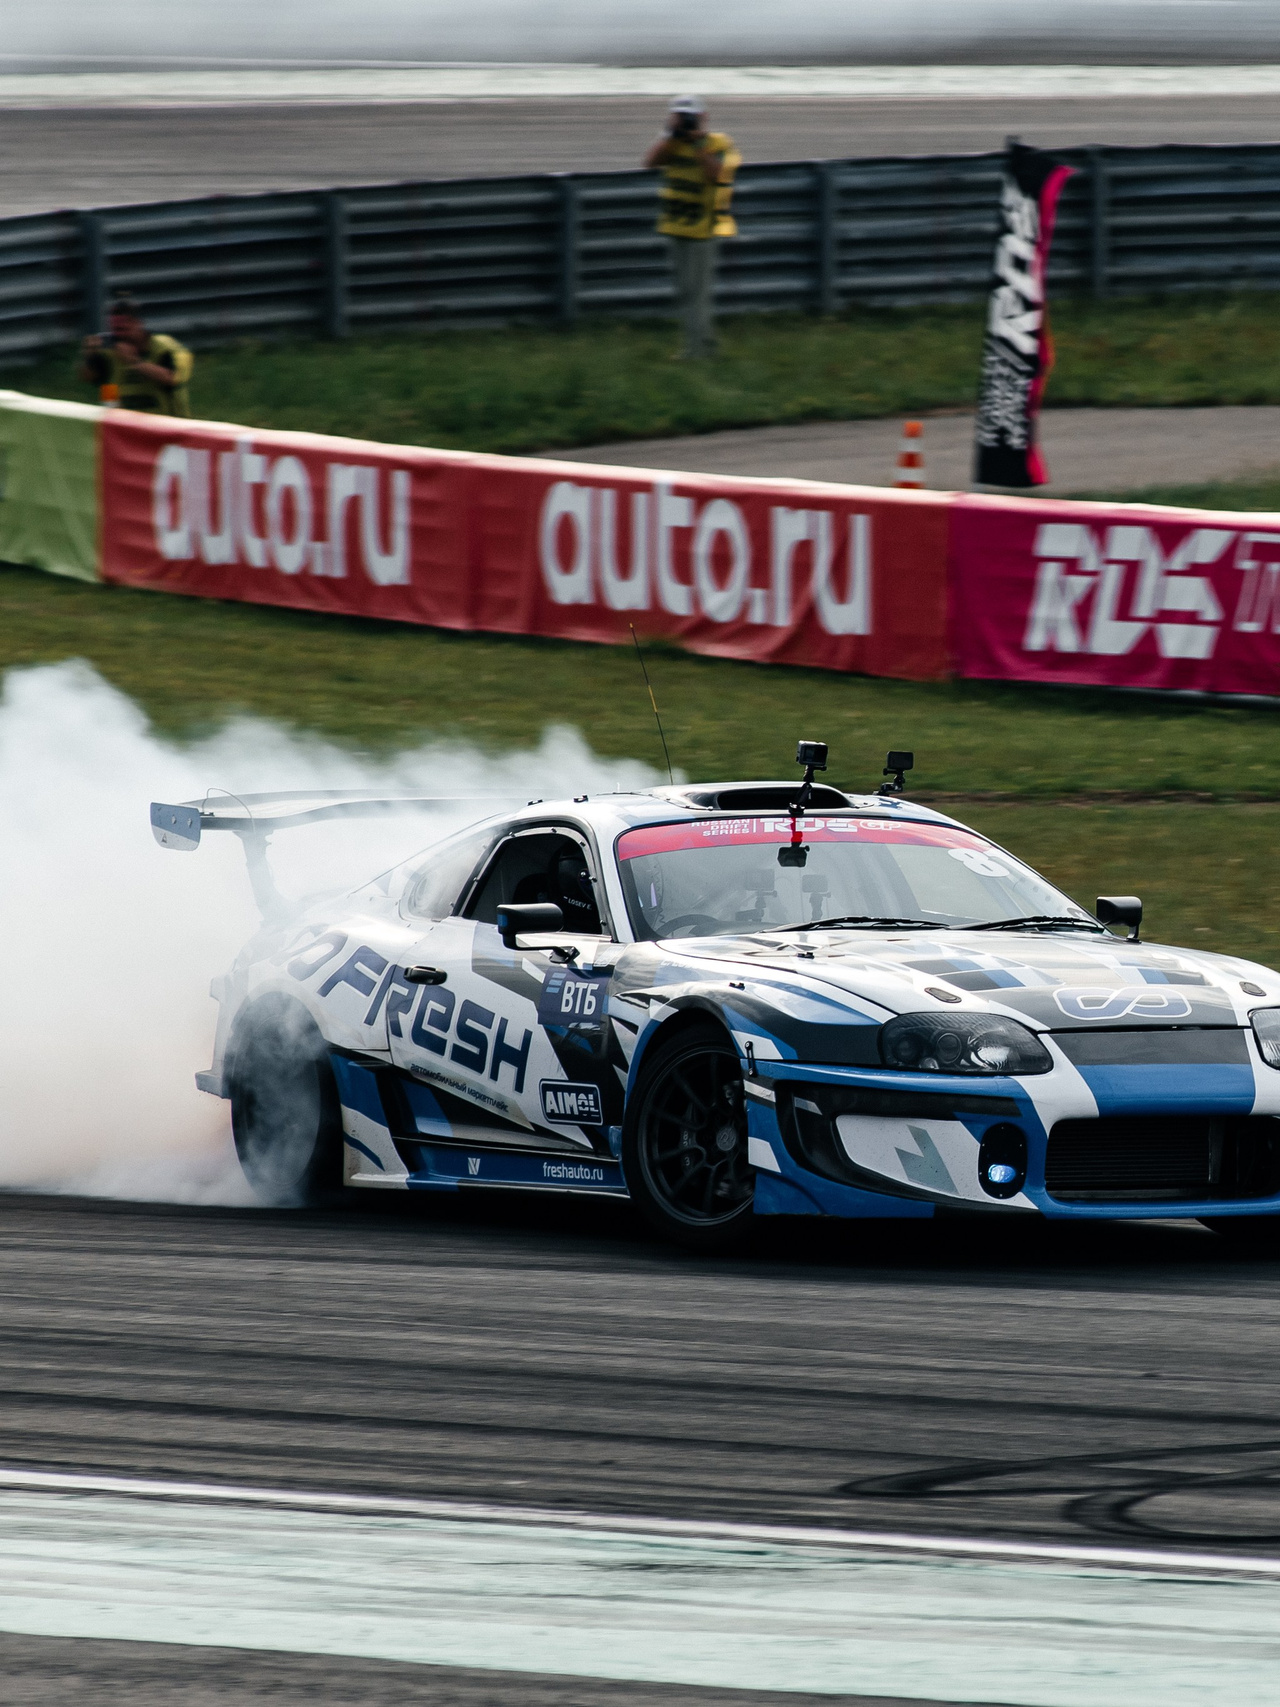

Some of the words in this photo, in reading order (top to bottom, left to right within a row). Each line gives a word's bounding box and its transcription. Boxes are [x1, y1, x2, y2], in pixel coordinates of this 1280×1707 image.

[153, 434, 411, 586] auto.ru
[539, 476, 872, 635] auto.ru
[1022, 523, 1238, 660] RDS
[691, 818, 750, 827] RUSSIAN
[702, 828, 750, 837] SERIES
[711, 823, 749, 831] DRIFT
[760, 817, 858, 833] RDS
[561, 980, 599, 1015] ВТБ
[546, 1091, 599, 1115] AIMOL
[543, 1161, 603, 1180] freshauto.ru
